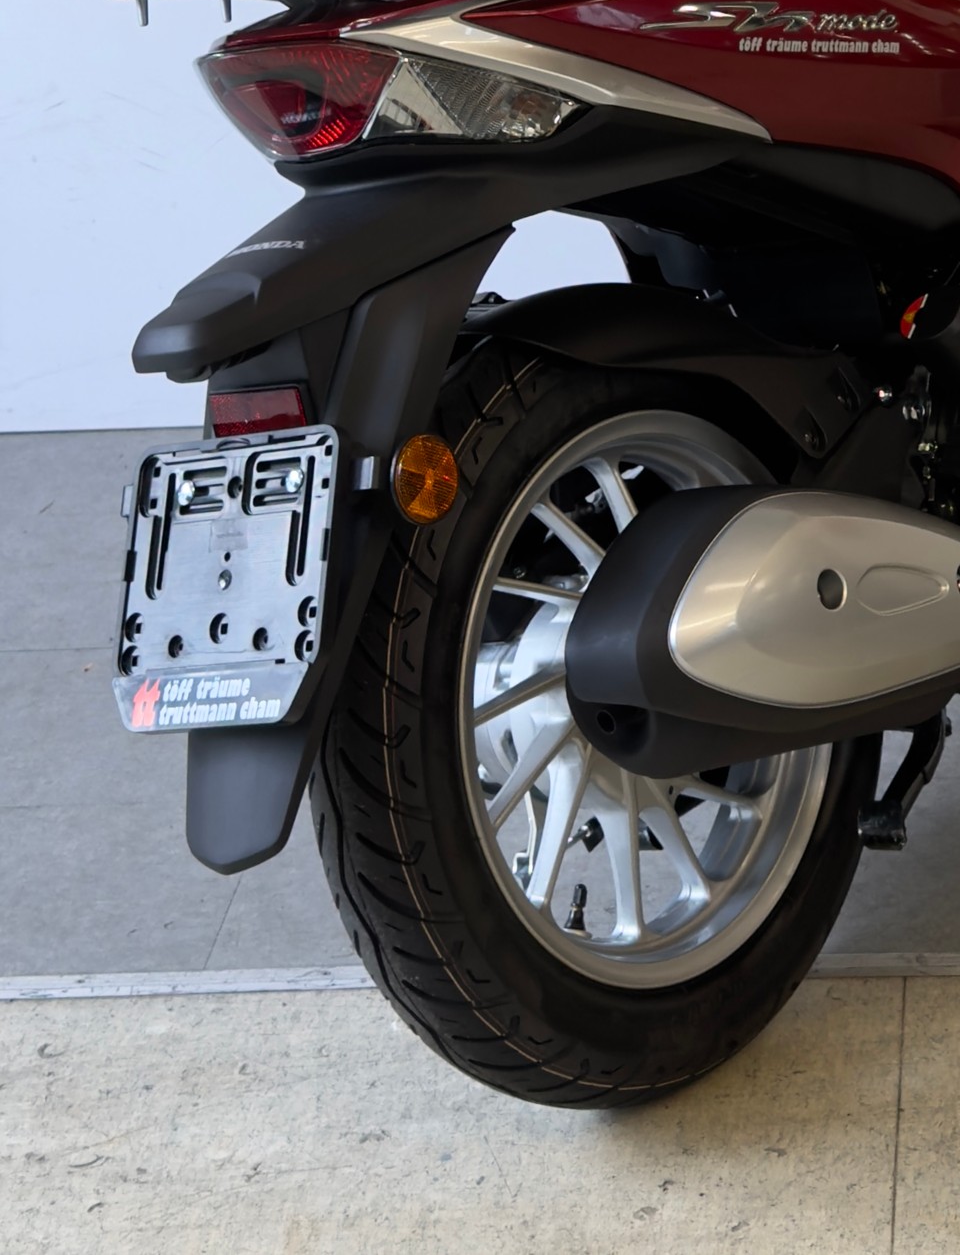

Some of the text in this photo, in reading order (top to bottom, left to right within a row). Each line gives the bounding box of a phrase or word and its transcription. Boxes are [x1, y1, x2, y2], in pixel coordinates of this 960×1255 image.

[816, 9, 900, 33] mode
[739, 37, 901, 54] töff träume truttmann cham
[163, 677, 250, 702] töff träume
[158, 697, 281, 725] truttmann cham
